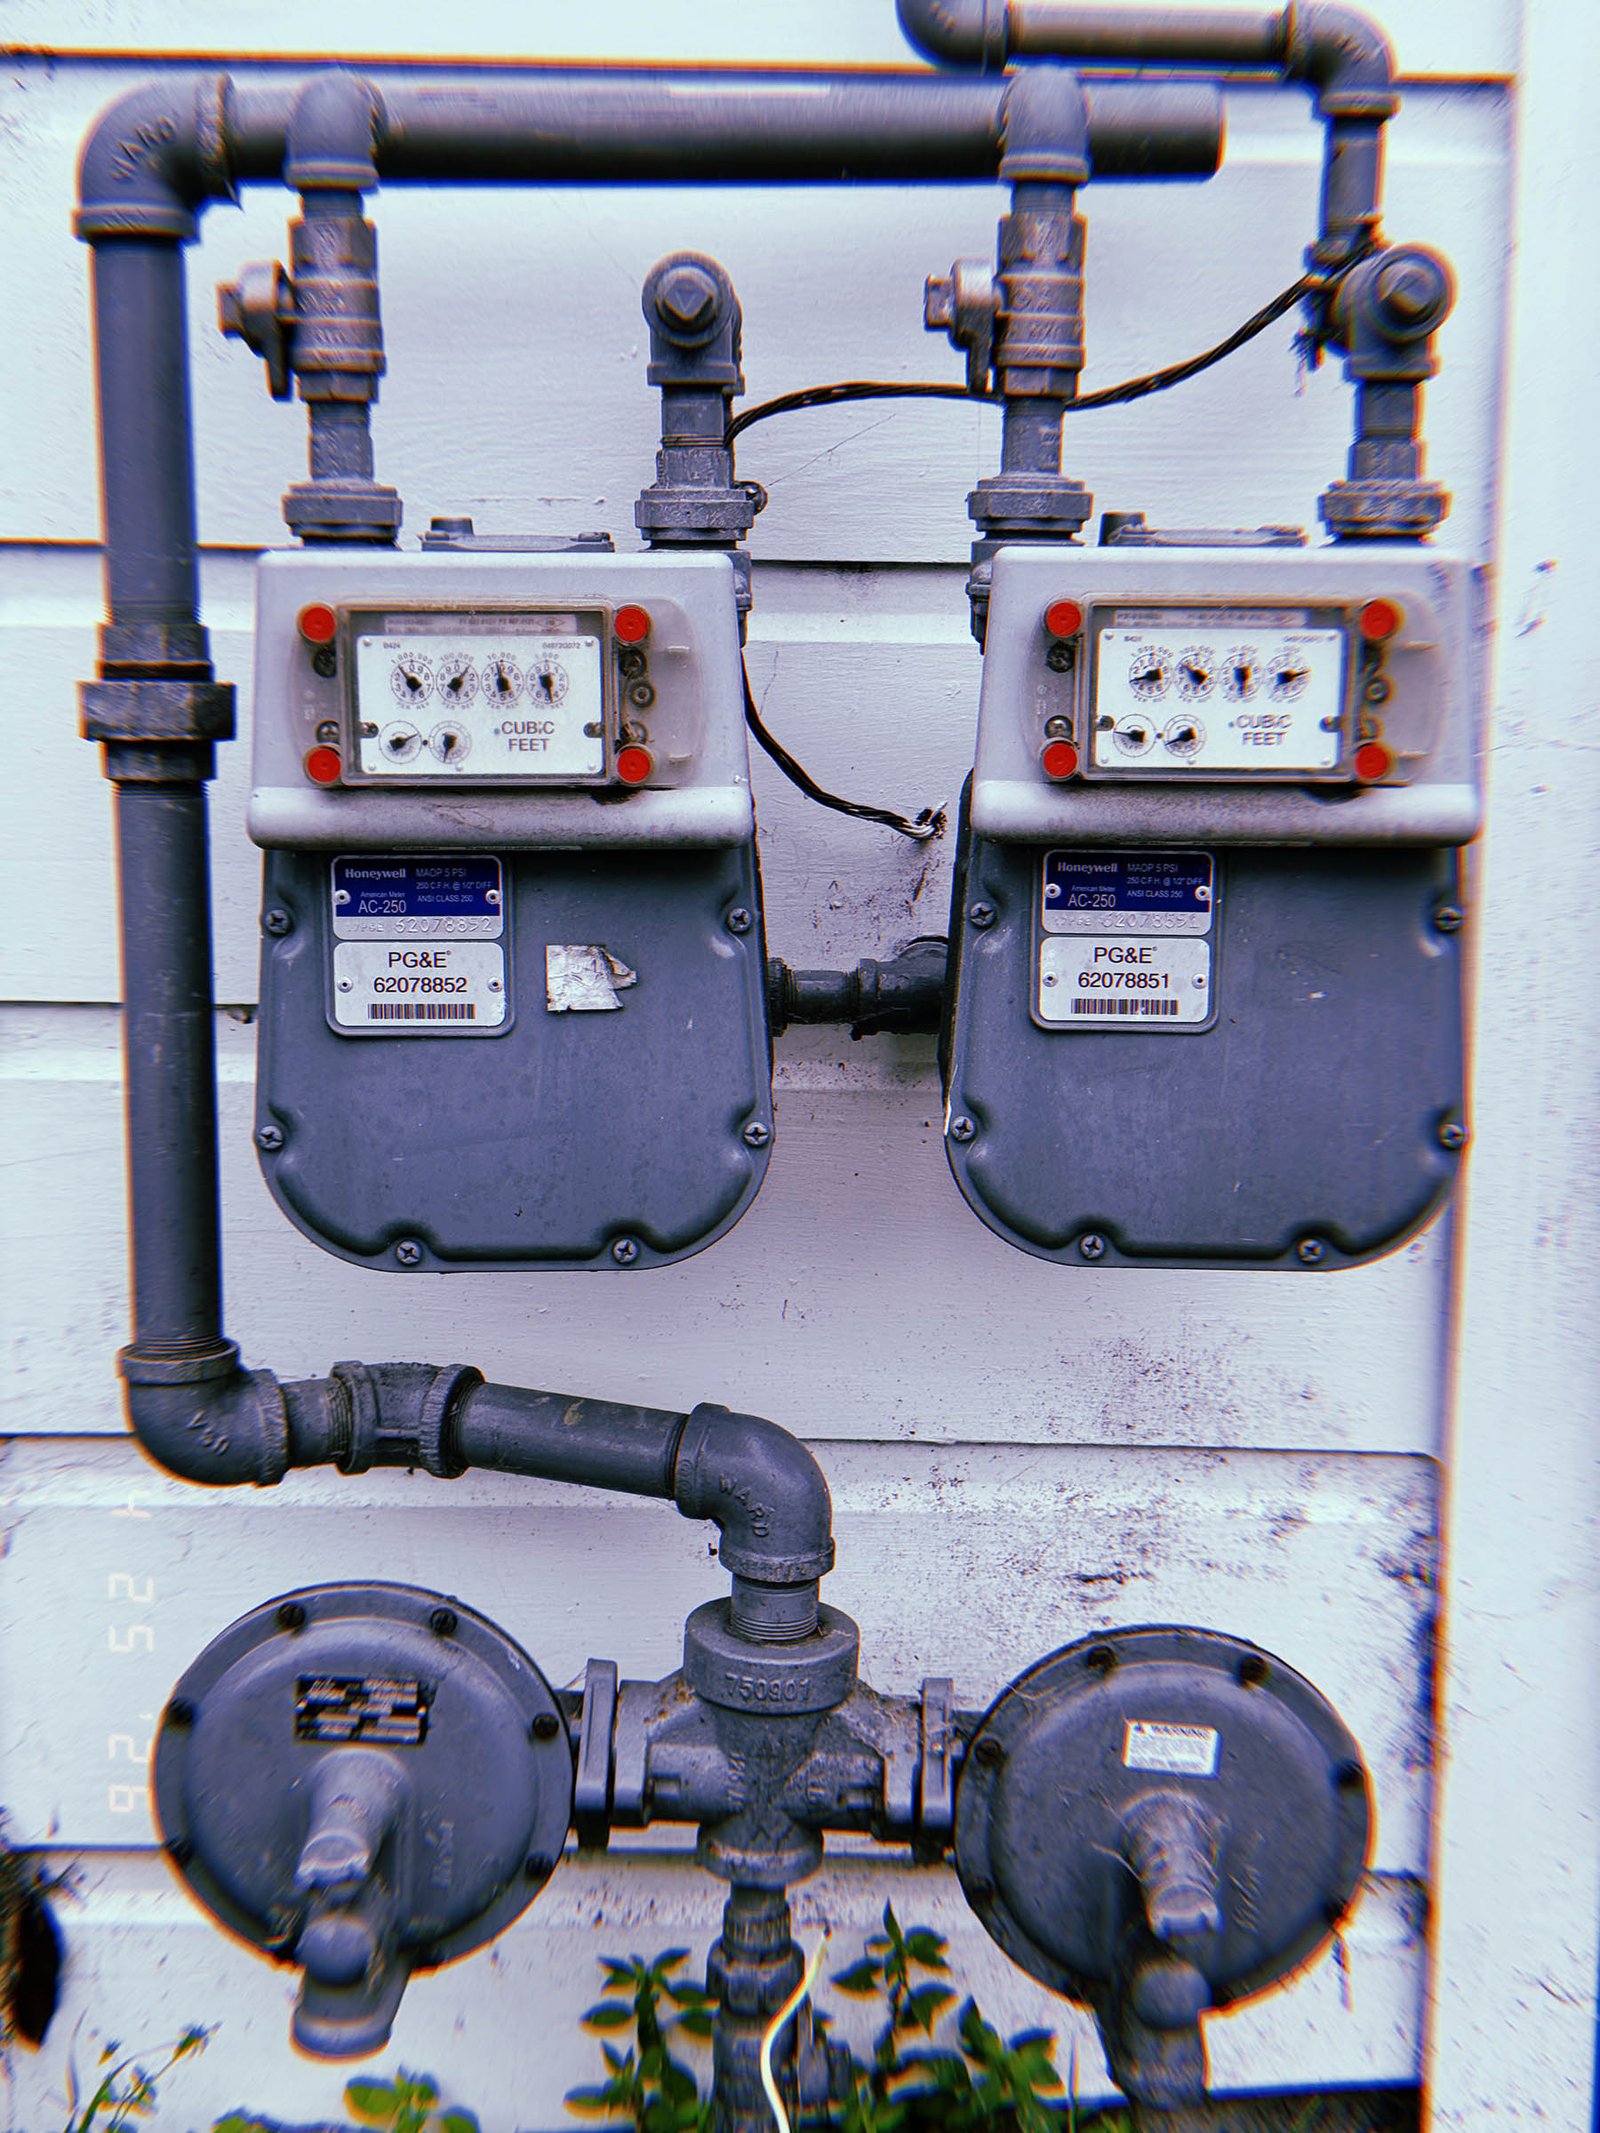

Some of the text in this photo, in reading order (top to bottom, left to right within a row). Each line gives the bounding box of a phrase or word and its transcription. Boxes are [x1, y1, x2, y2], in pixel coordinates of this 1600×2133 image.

[501, 721, 555, 735] CUBIC
[1236, 714, 1293, 729] CUBIC
[508, 738, 550, 752] FEET
[1242, 731, 1288, 746] FEET
[345, 868, 406, 880] Honeywell
[452, 868, 467, 878] PSI
[1058, 862, 1118, 874] Honeywell
[1163, 864, 1179, 872] PSI
[416, 882, 430, 890] 250
[1126, 876, 1140, 884] 250
[417, 895, 474, 903] ANSI CLASS 250
[1068, 894, 1116, 908] AC-250
[1126, 890, 1183, 898] ANSI CLASS 250
[358, 900, 407, 914] AC-250
[373, 977, 468, 993] 62078852
[1078, 972, 1169, 988] 62078851
[719, 1473, 771, 1538] WARD
[725, 1671, 811, 1701] 750901
